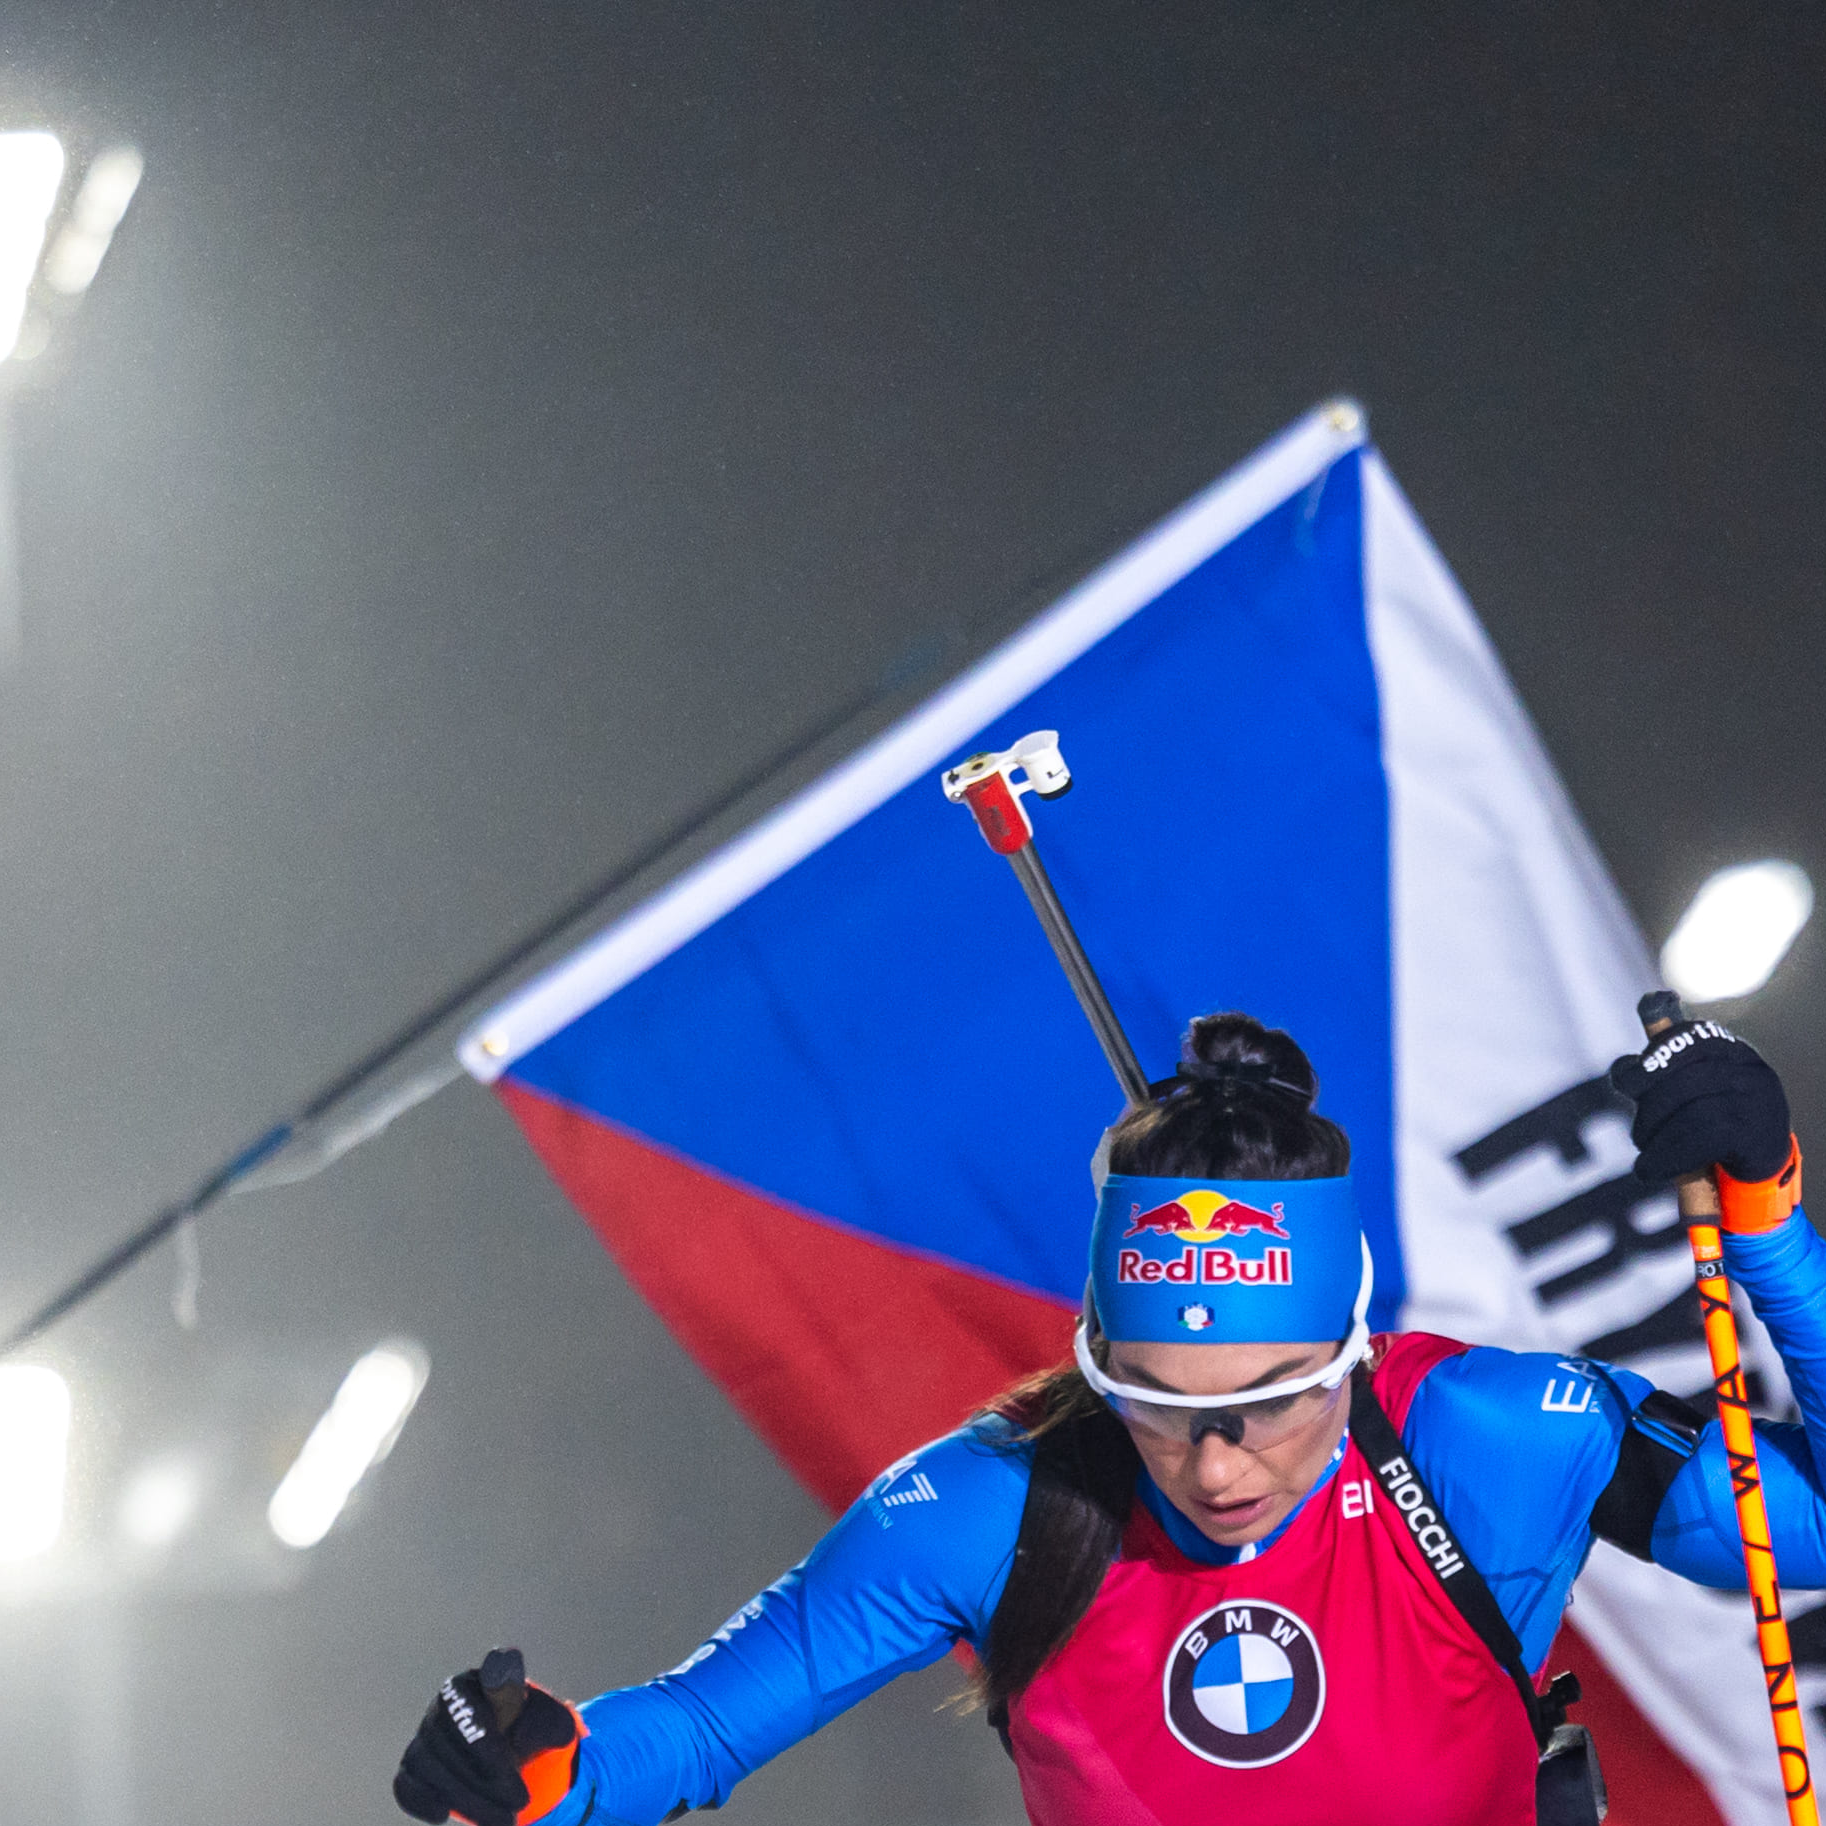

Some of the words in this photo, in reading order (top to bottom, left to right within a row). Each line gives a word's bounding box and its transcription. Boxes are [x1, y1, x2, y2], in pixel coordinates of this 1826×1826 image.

[1642, 1021, 1736, 1072] sportfu
[1118, 1247, 1198, 1284] Red
[1201, 1247, 1293, 1286] Bull
[1379, 1456, 1465, 1579] FIOCCHI
[1185, 1608, 1299, 1659] BMW
